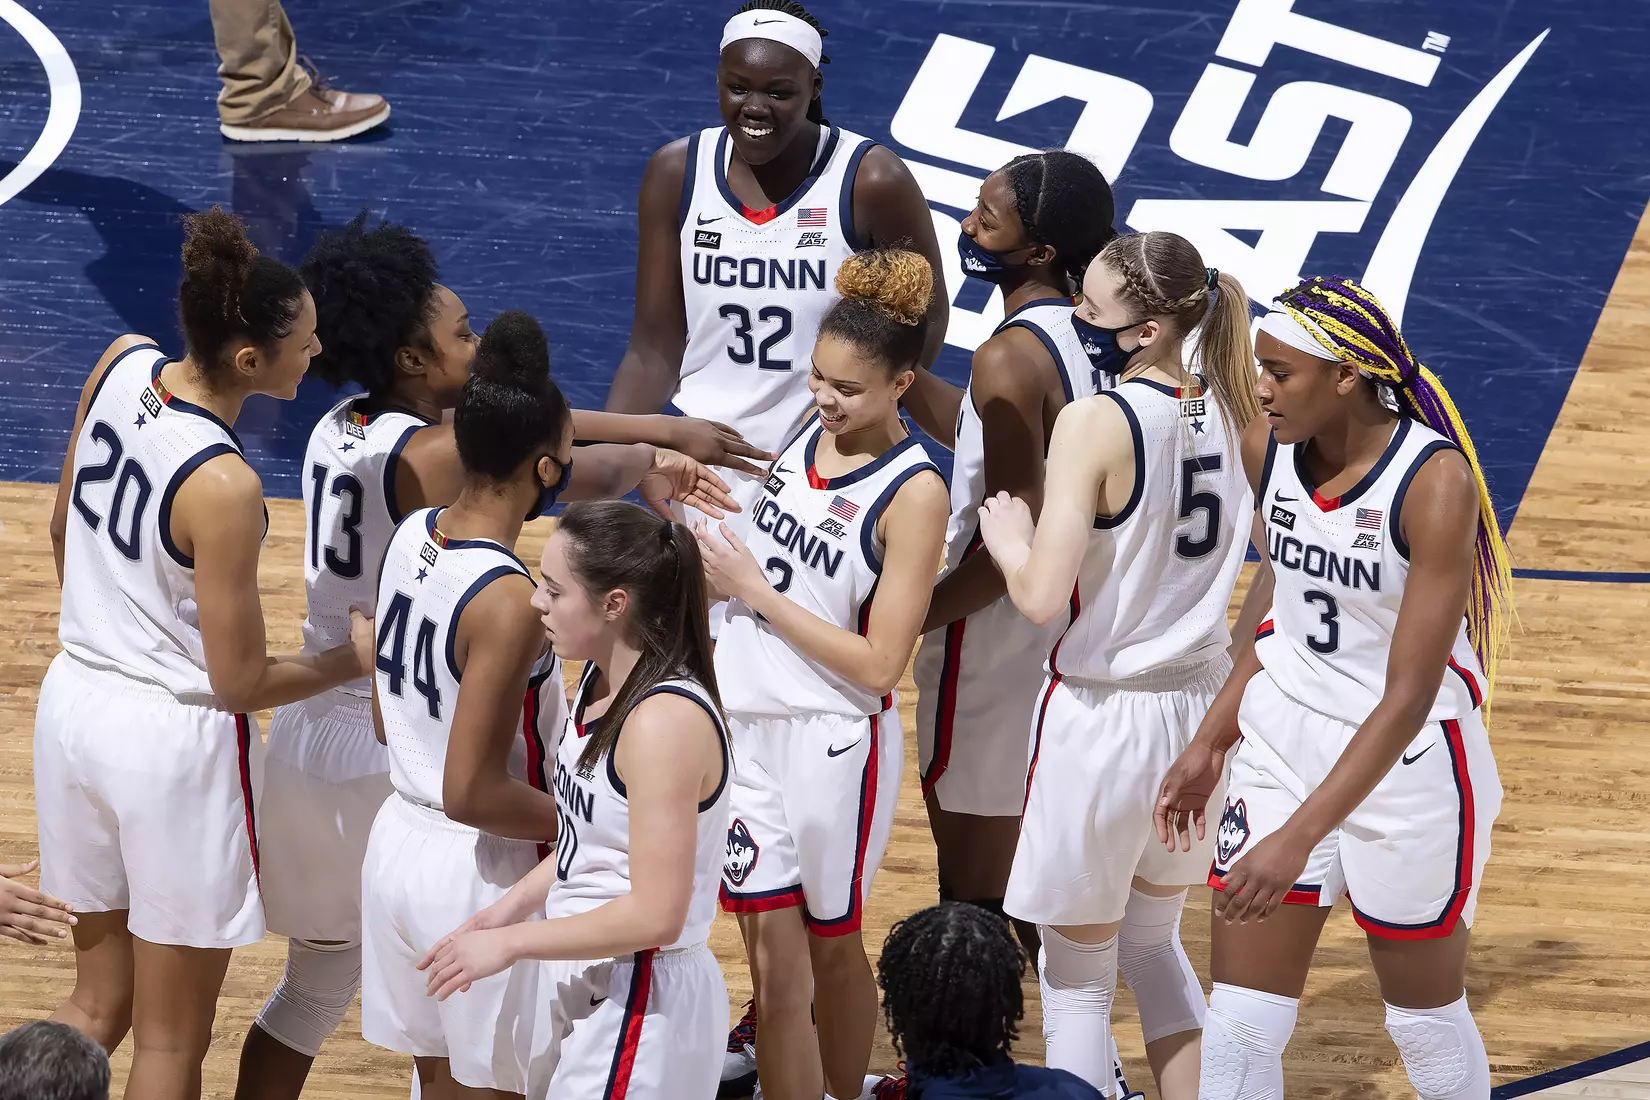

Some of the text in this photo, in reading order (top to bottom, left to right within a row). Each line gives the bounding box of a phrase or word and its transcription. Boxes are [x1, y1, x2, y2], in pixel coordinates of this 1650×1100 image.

[696, 232, 719, 243] BLM
[798, 238, 828, 246] EAST
[693, 253, 826, 291] UCONN
[718, 303, 793, 372] 32
[142, 389, 162, 417] DEE
[347, 421, 365, 438] DEE
[72, 420, 153, 563] 20
[1175, 452, 1223, 559] 5
[1273, 509, 1293, 522] BLM
[311, 461, 364, 580] 13
[819, 522, 847, 537] EAST
[825, 518, 845, 530] BIG
[1353, 539, 1381, 548] EAST
[1357, 533, 1376, 541] BIG
[421, 544, 437, 565] DEE
[1268, 528, 1382, 592] UCONN
[1303, 590, 1340, 655] 3
[376, 589, 443, 723] 44
